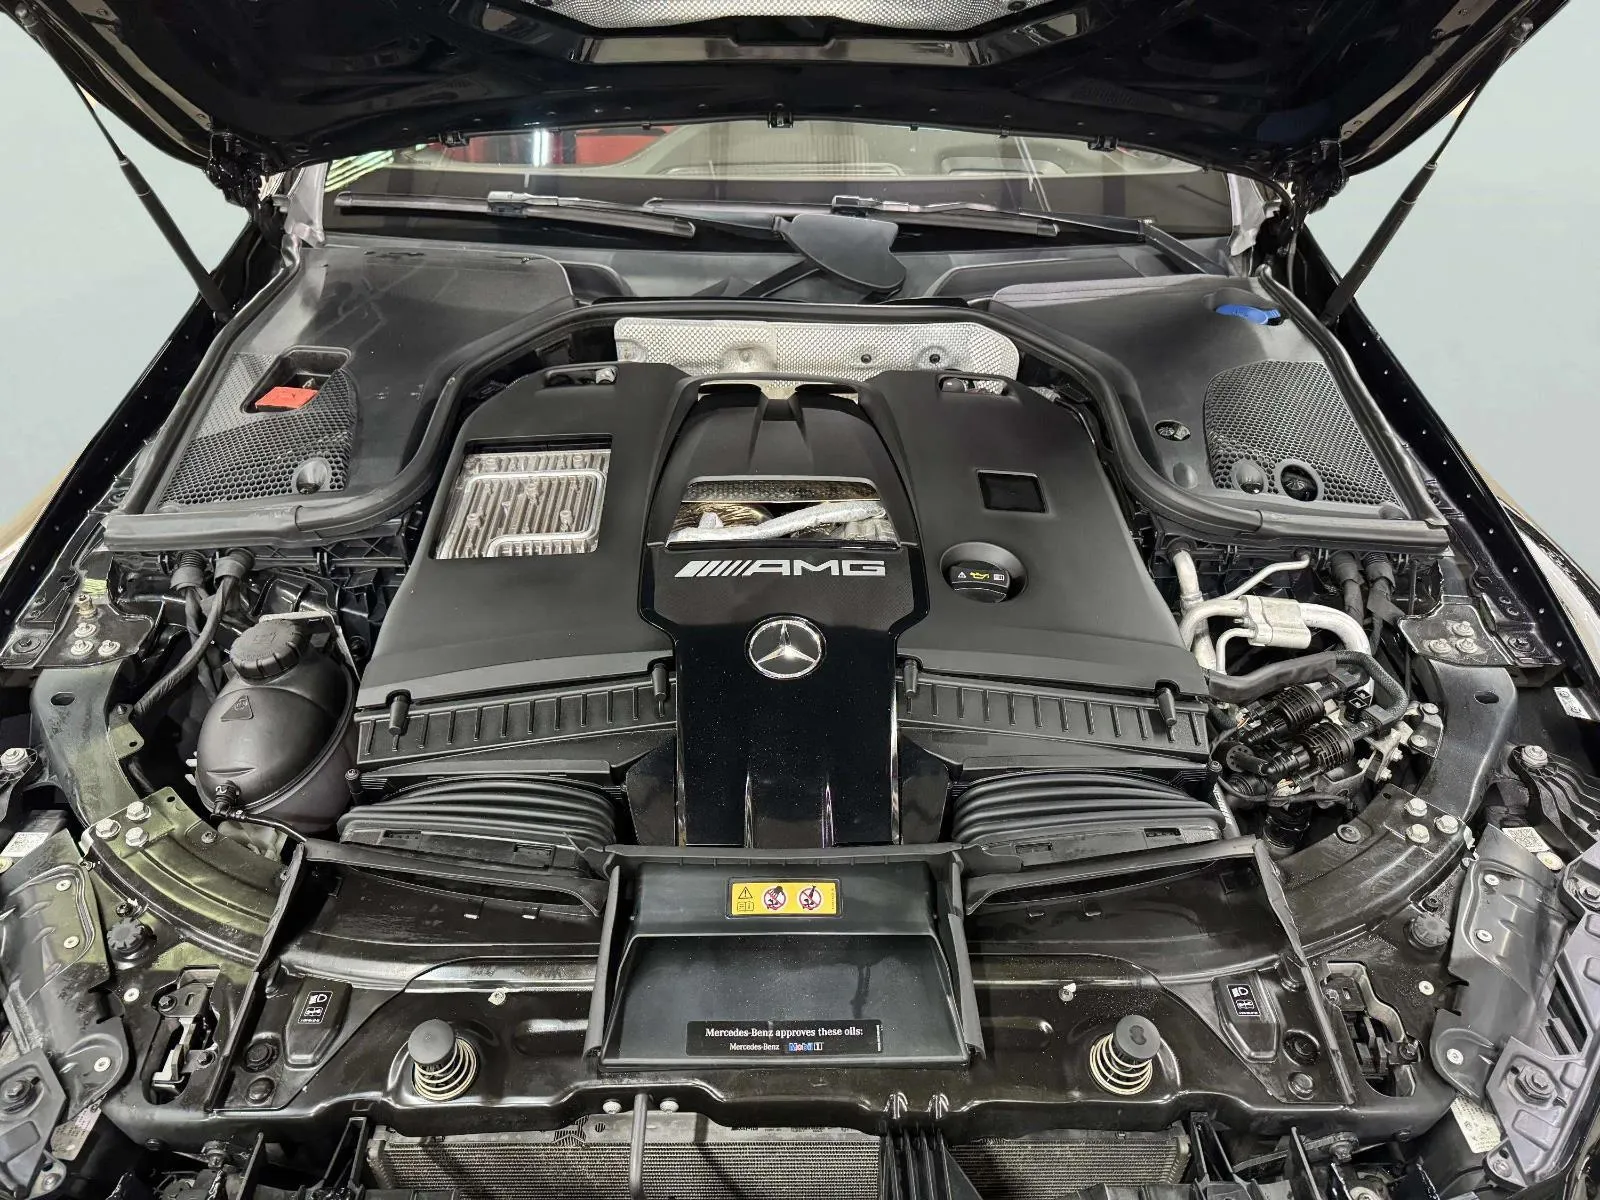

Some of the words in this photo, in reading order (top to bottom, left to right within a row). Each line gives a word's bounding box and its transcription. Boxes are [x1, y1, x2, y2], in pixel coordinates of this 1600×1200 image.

[742, 560, 886, 577] AMG
[705, 1027, 773, 1037] Mercedes-Benz
[775, 1028, 816, 1039] approves
[818, 1027, 843, 1036] these
[844, 1027, 863, 1036] oils:
[729, 1043, 780, 1051] Mercedes-Benz
[788, 1042, 813, 1051] Mobil
